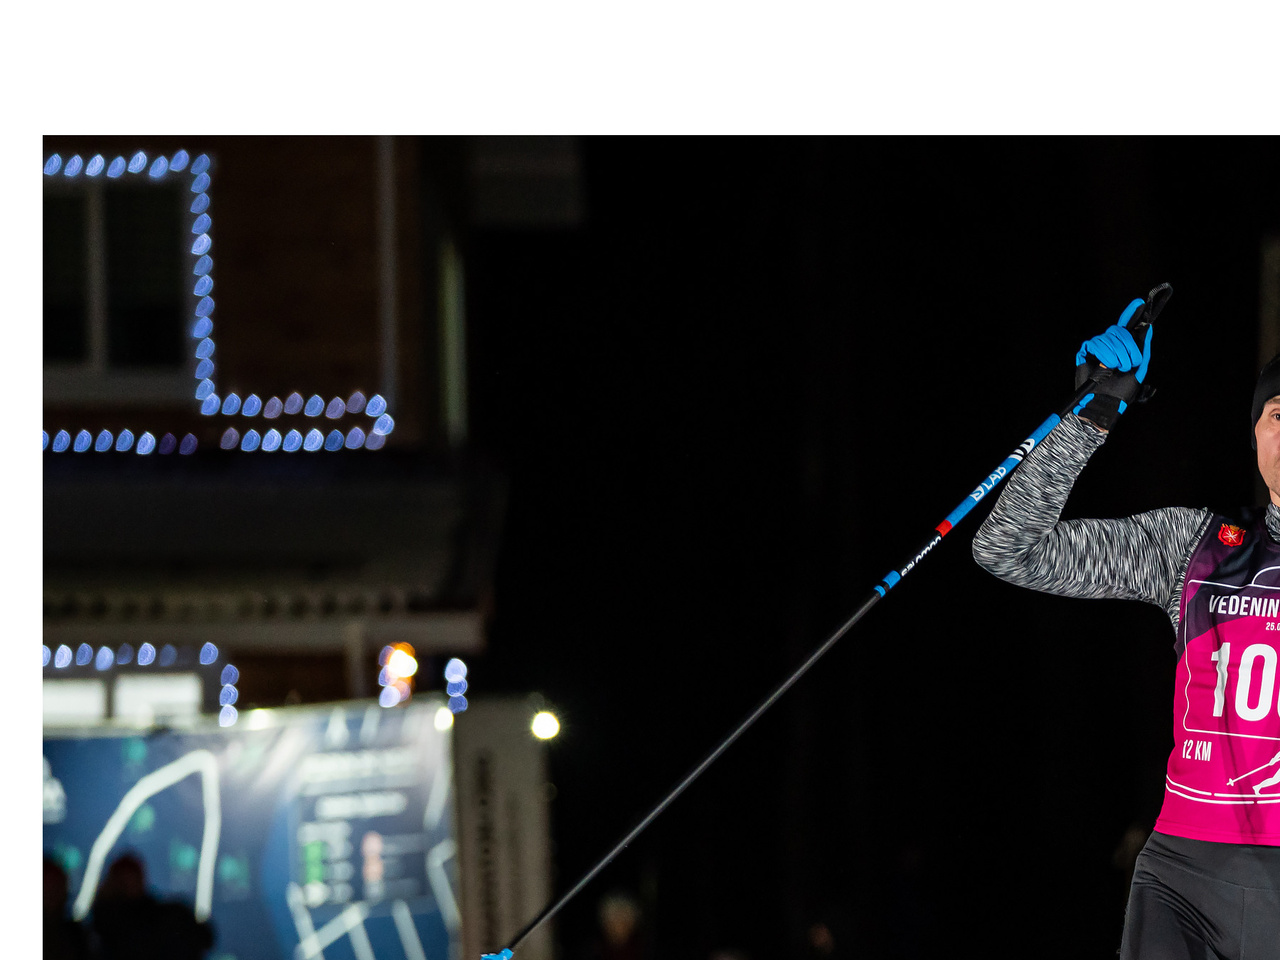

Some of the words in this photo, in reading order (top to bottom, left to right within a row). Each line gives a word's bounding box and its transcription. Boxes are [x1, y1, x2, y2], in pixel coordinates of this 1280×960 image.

[1208, 594, 1280, 618] VEDENIN
[1182, 739, 1194, 760] 12
[1194, 740, 1213, 762] KM
